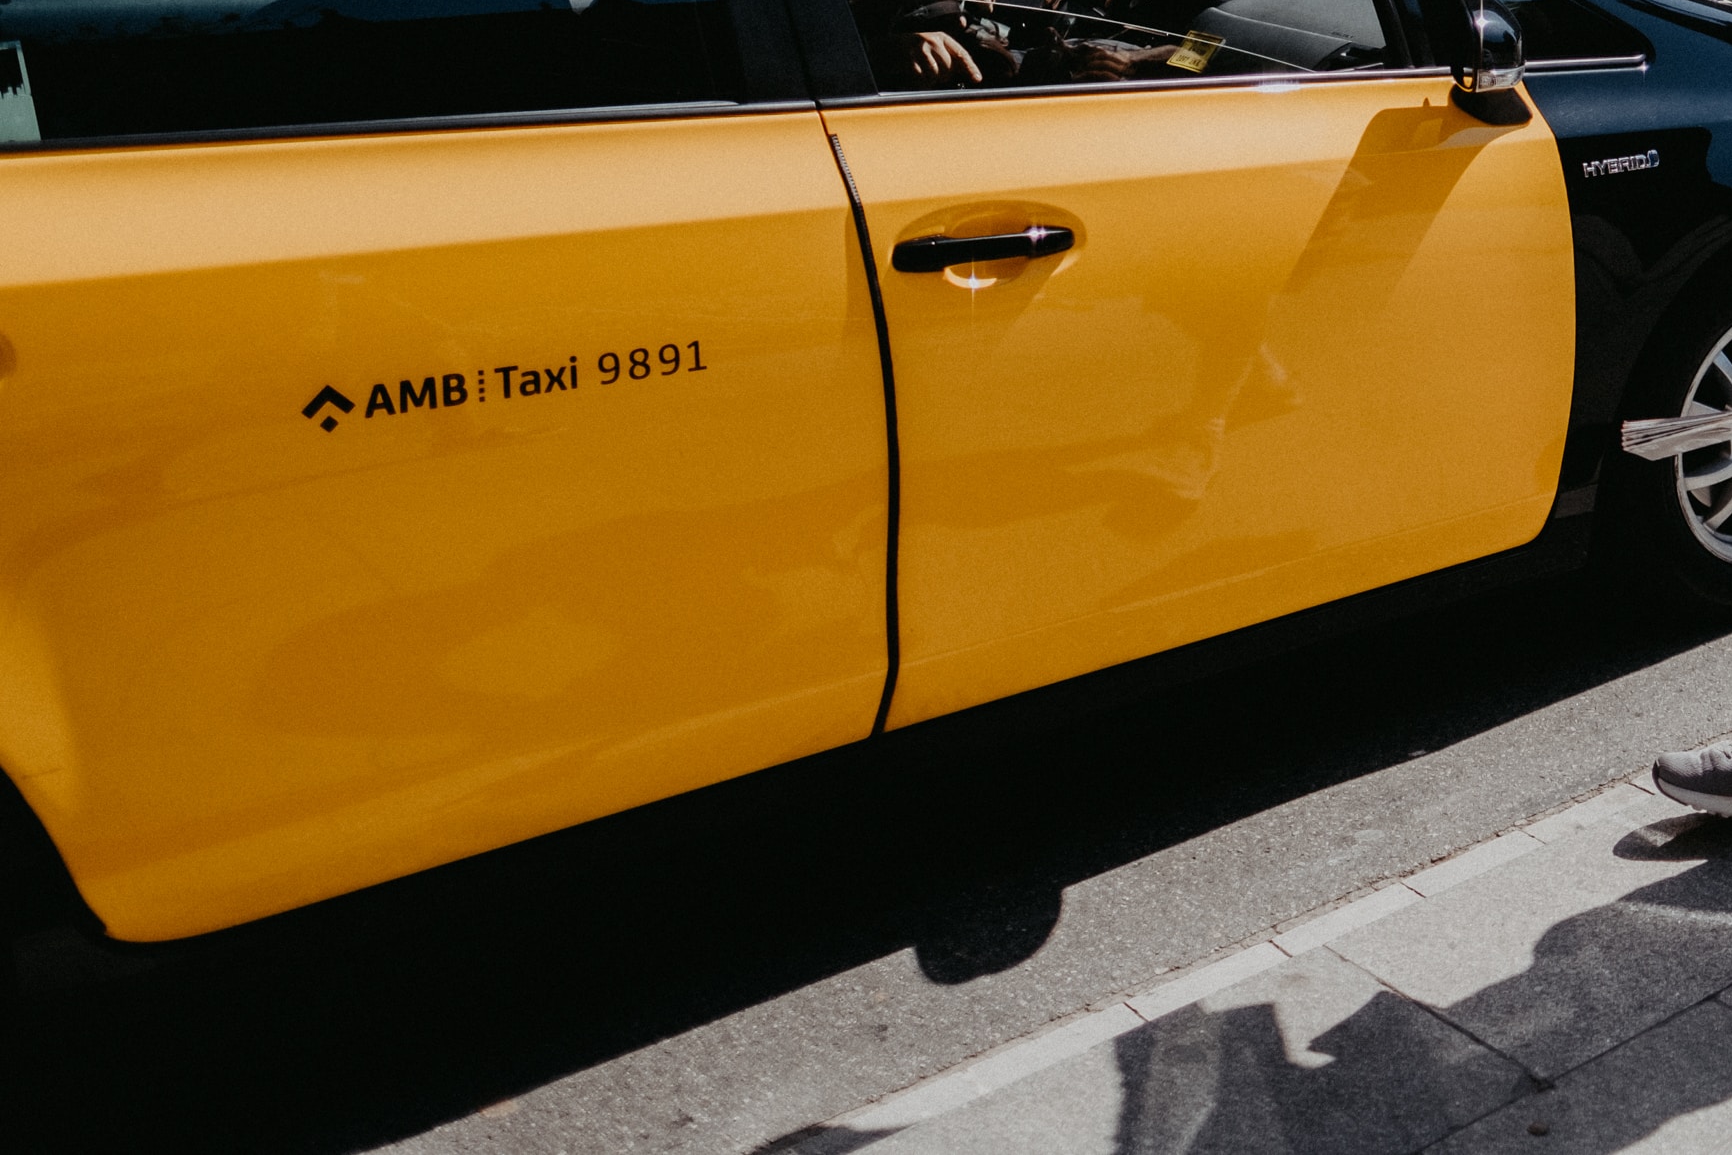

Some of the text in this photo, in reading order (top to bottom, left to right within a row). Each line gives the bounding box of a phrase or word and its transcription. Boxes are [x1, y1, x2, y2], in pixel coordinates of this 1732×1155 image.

[1582, 153, 1648, 178] HYBRID
[364, 340, 708, 419] AMB Taxi 9891
